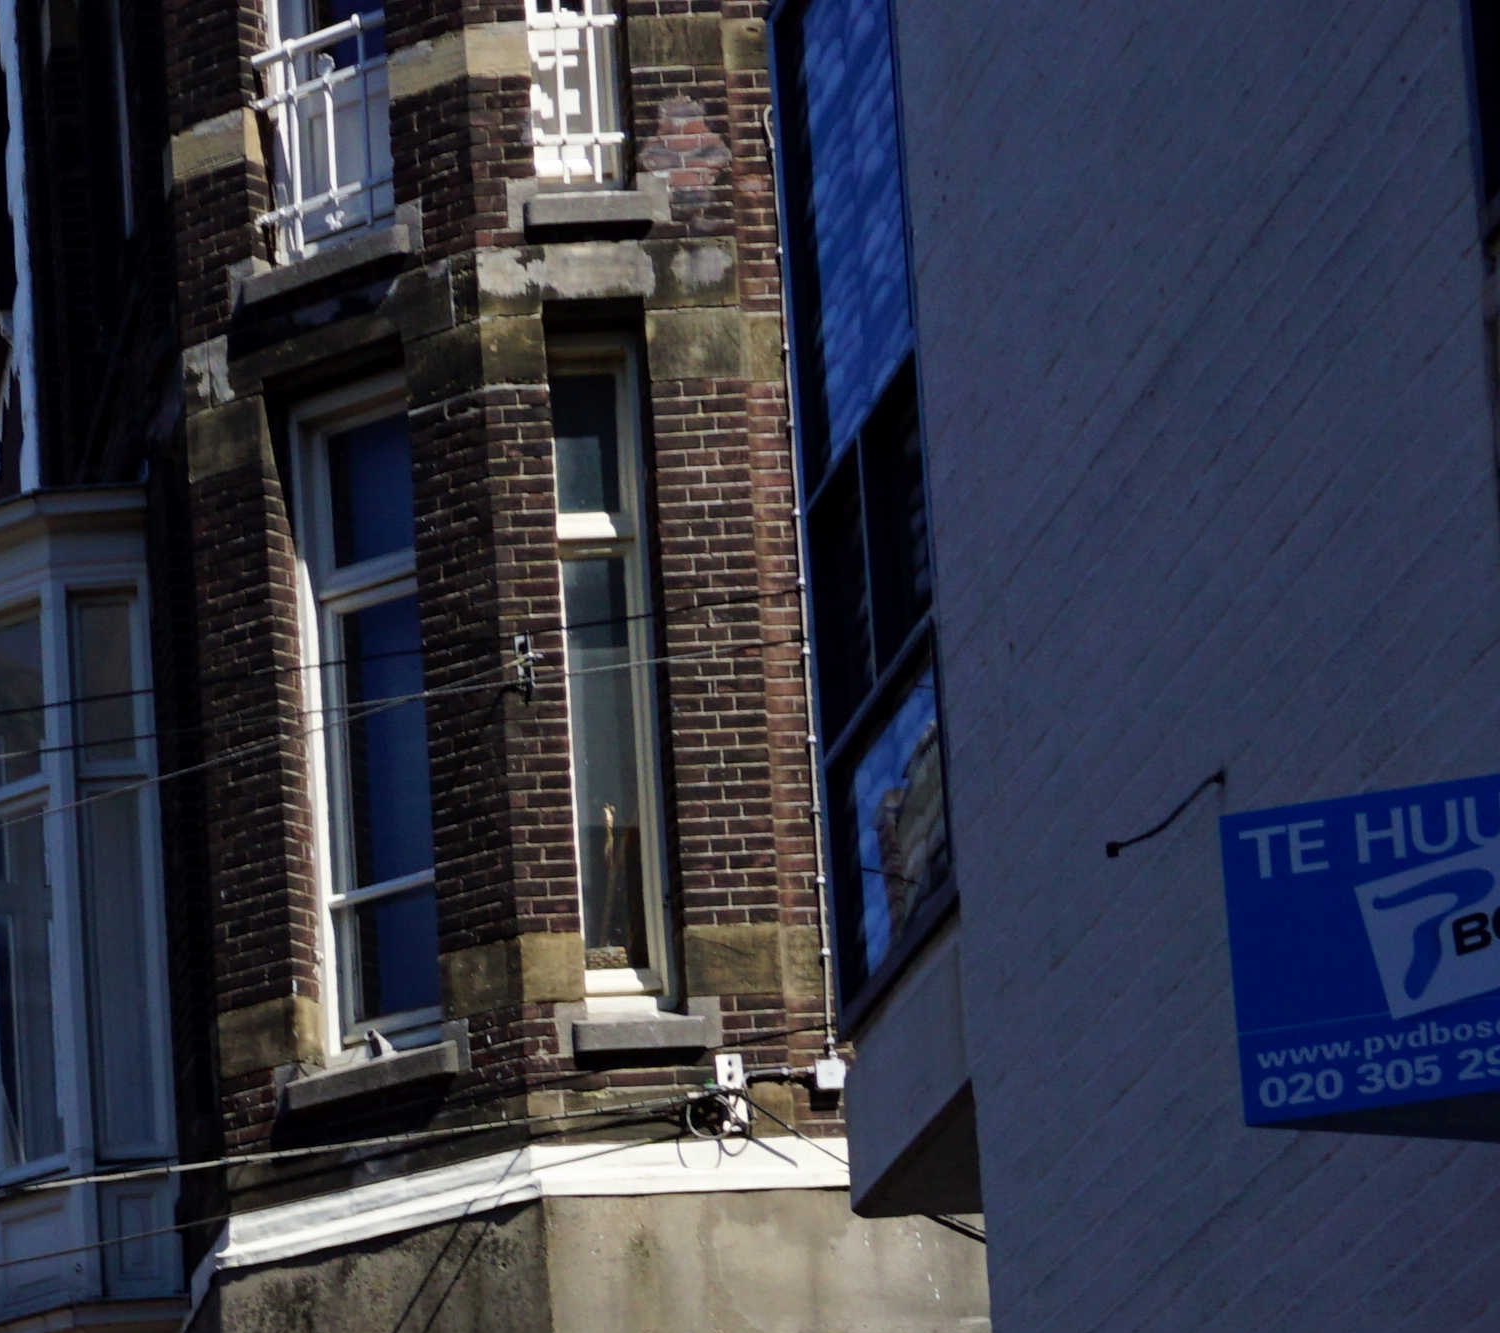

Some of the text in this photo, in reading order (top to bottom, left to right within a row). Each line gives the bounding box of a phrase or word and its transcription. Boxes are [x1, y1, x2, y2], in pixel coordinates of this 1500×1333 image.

[1238, 818, 1330, 880] TE
[1257, 1015, 1500, 1071] www.pvdbos
[1258, 1070, 1344, 1108] 020
[1357, 1055, 1442, 1095] 305
